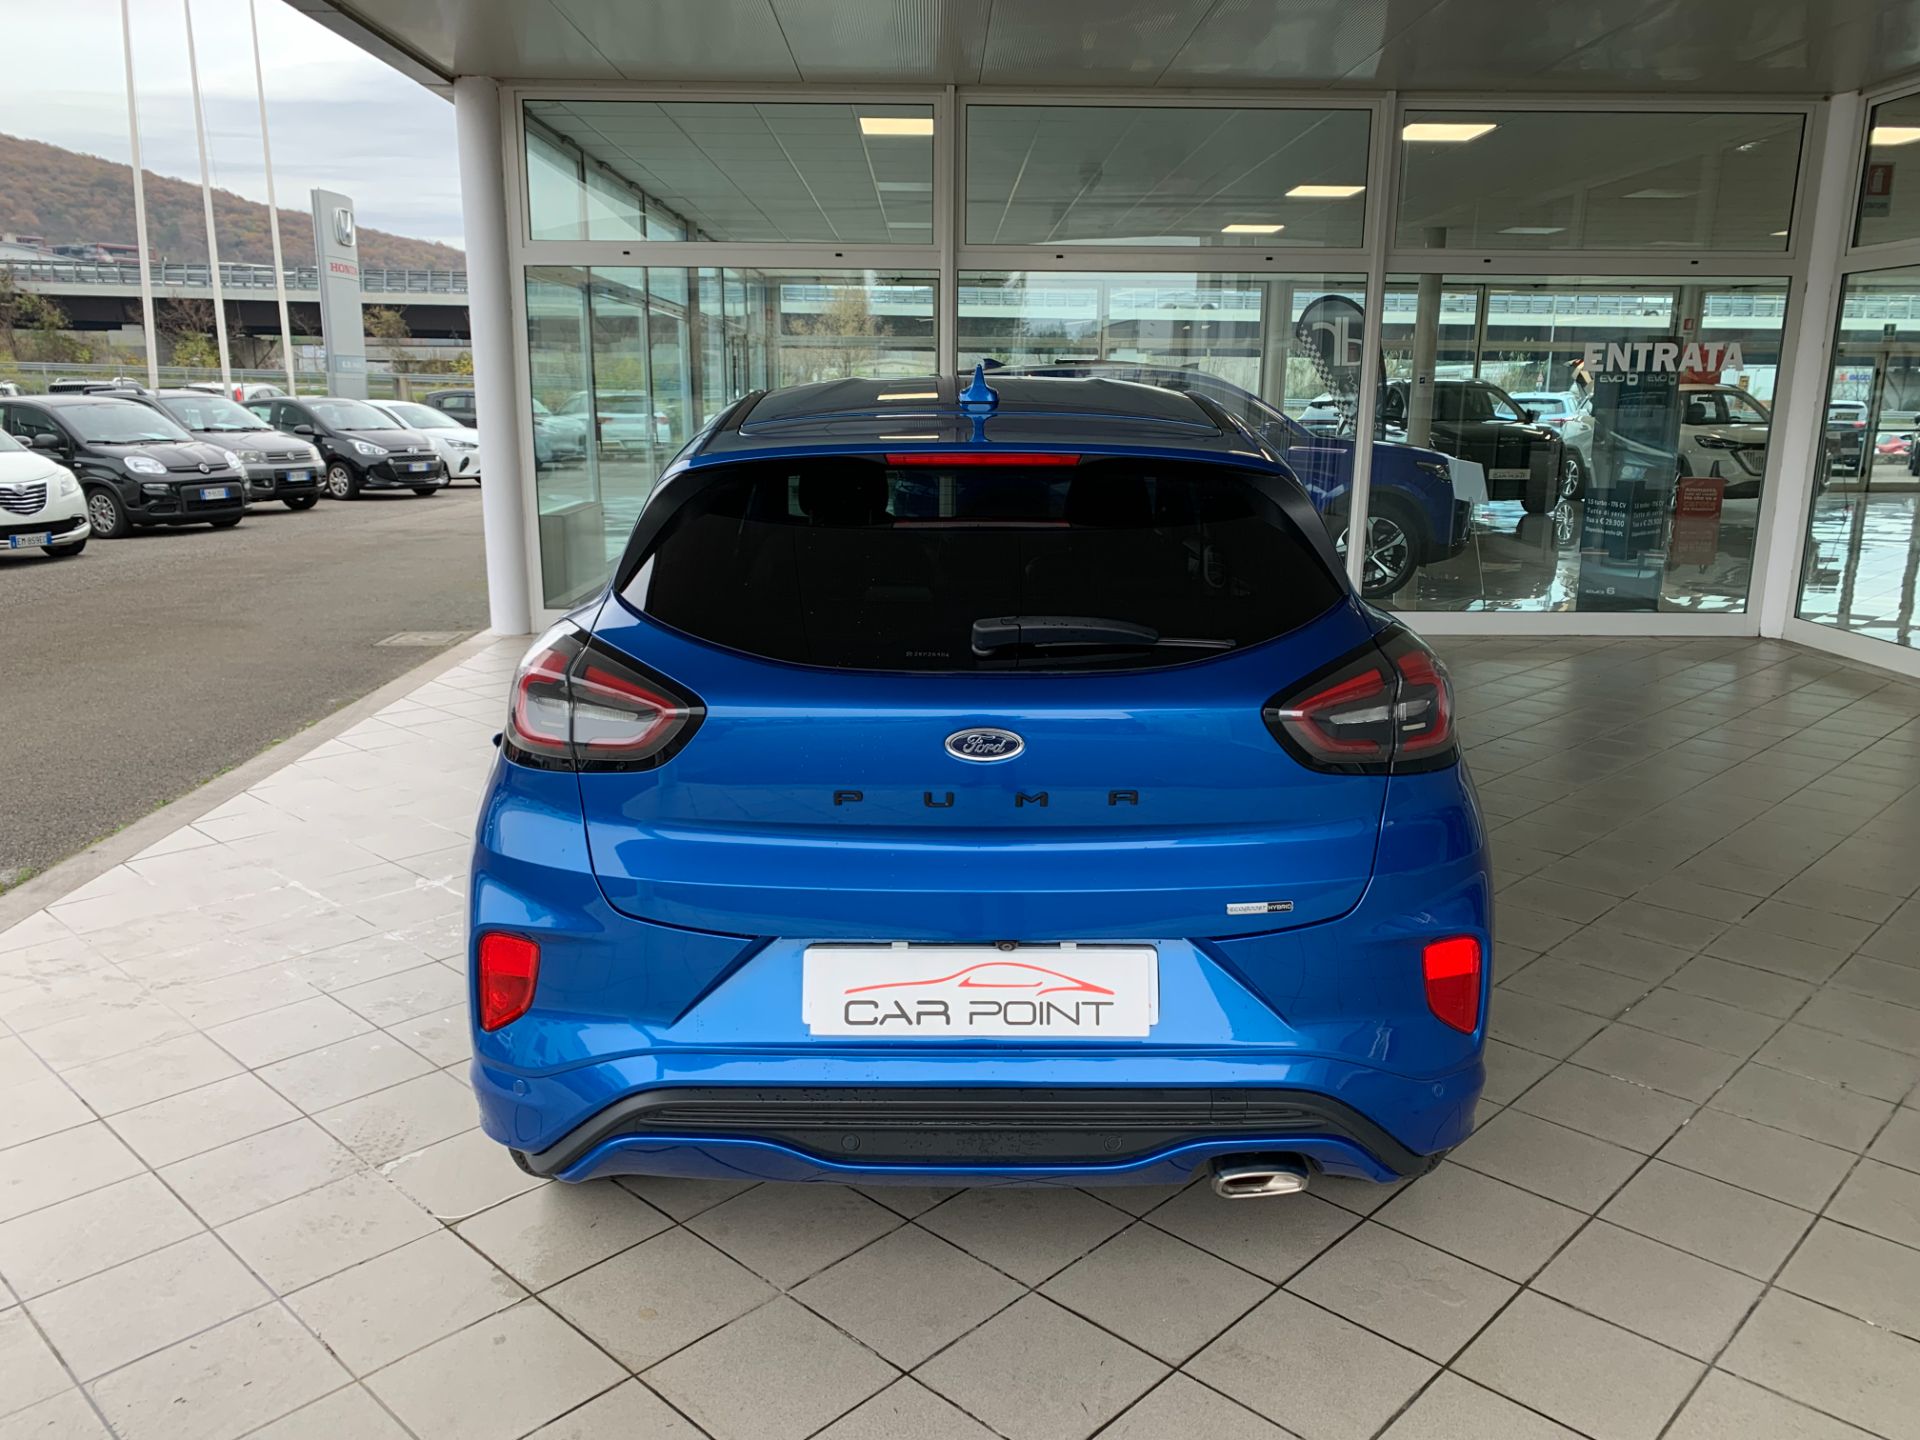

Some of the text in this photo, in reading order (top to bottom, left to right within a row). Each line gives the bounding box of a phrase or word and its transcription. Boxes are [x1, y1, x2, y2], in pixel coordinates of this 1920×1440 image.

[1583, 342, 1744, 372] ENTRATA
[1599, 374, 1625, 383] EVO
[962, 735, 1007, 754] Ford
[833, 789, 1139, 808] PUMA
[844, 1000, 1114, 1026] CAR POINT
